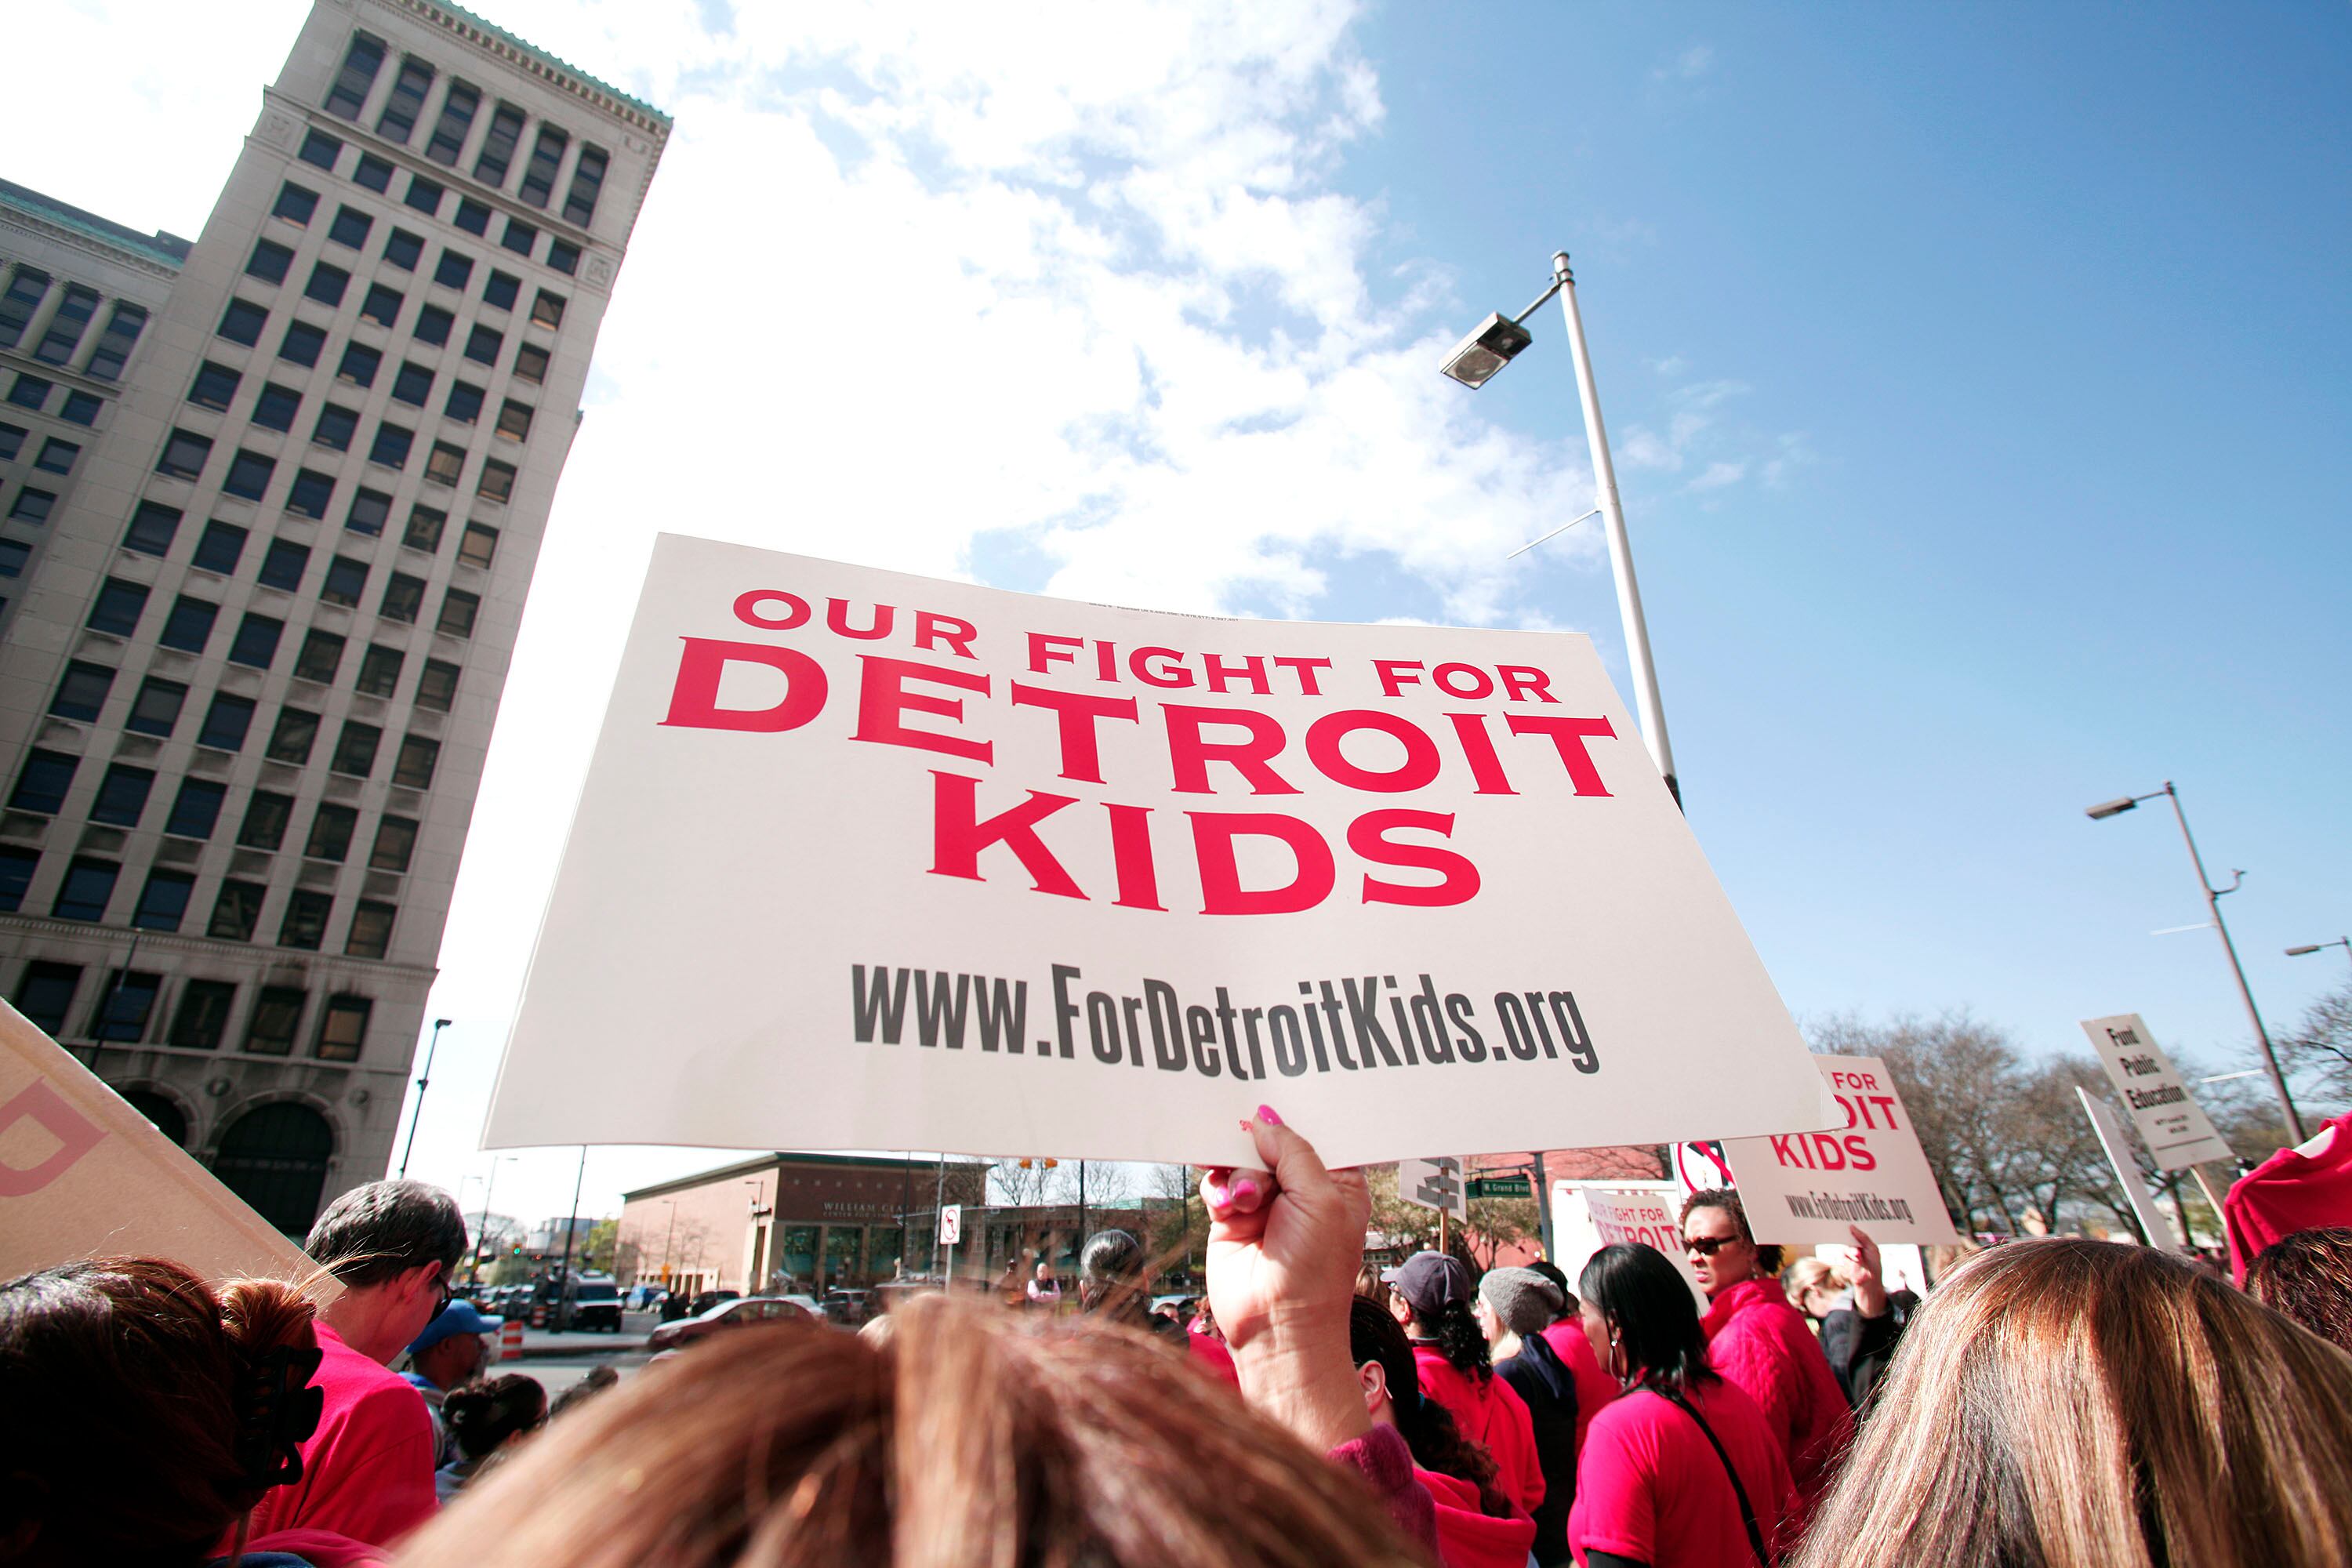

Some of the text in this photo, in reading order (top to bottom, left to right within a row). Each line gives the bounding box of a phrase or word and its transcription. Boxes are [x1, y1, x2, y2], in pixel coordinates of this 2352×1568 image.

[734, 590, 1561, 703] OUR FIGHT FOR
[658, 636, 1617, 797] DETROIT
[927, 769, 1481, 916] KIDS
[851, 963, 1600, 1081] www.ForDetroitKids.org
[2106, 1025, 2140, 1047] Fund
[2119, 1054, 2161, 1076] Public
[1831, 1072, 1879, 1091] FOR
[2125, 1083, 2187, 1109] Education
[1769, 1134, 1877, 1171] KIDS
[823, 1202, 876, 1212] WILLIAM
[1639, 1208, 1667, 1222] FOR
[1784, 1190, 1915, 1225] www.ForDetroitKids.org
